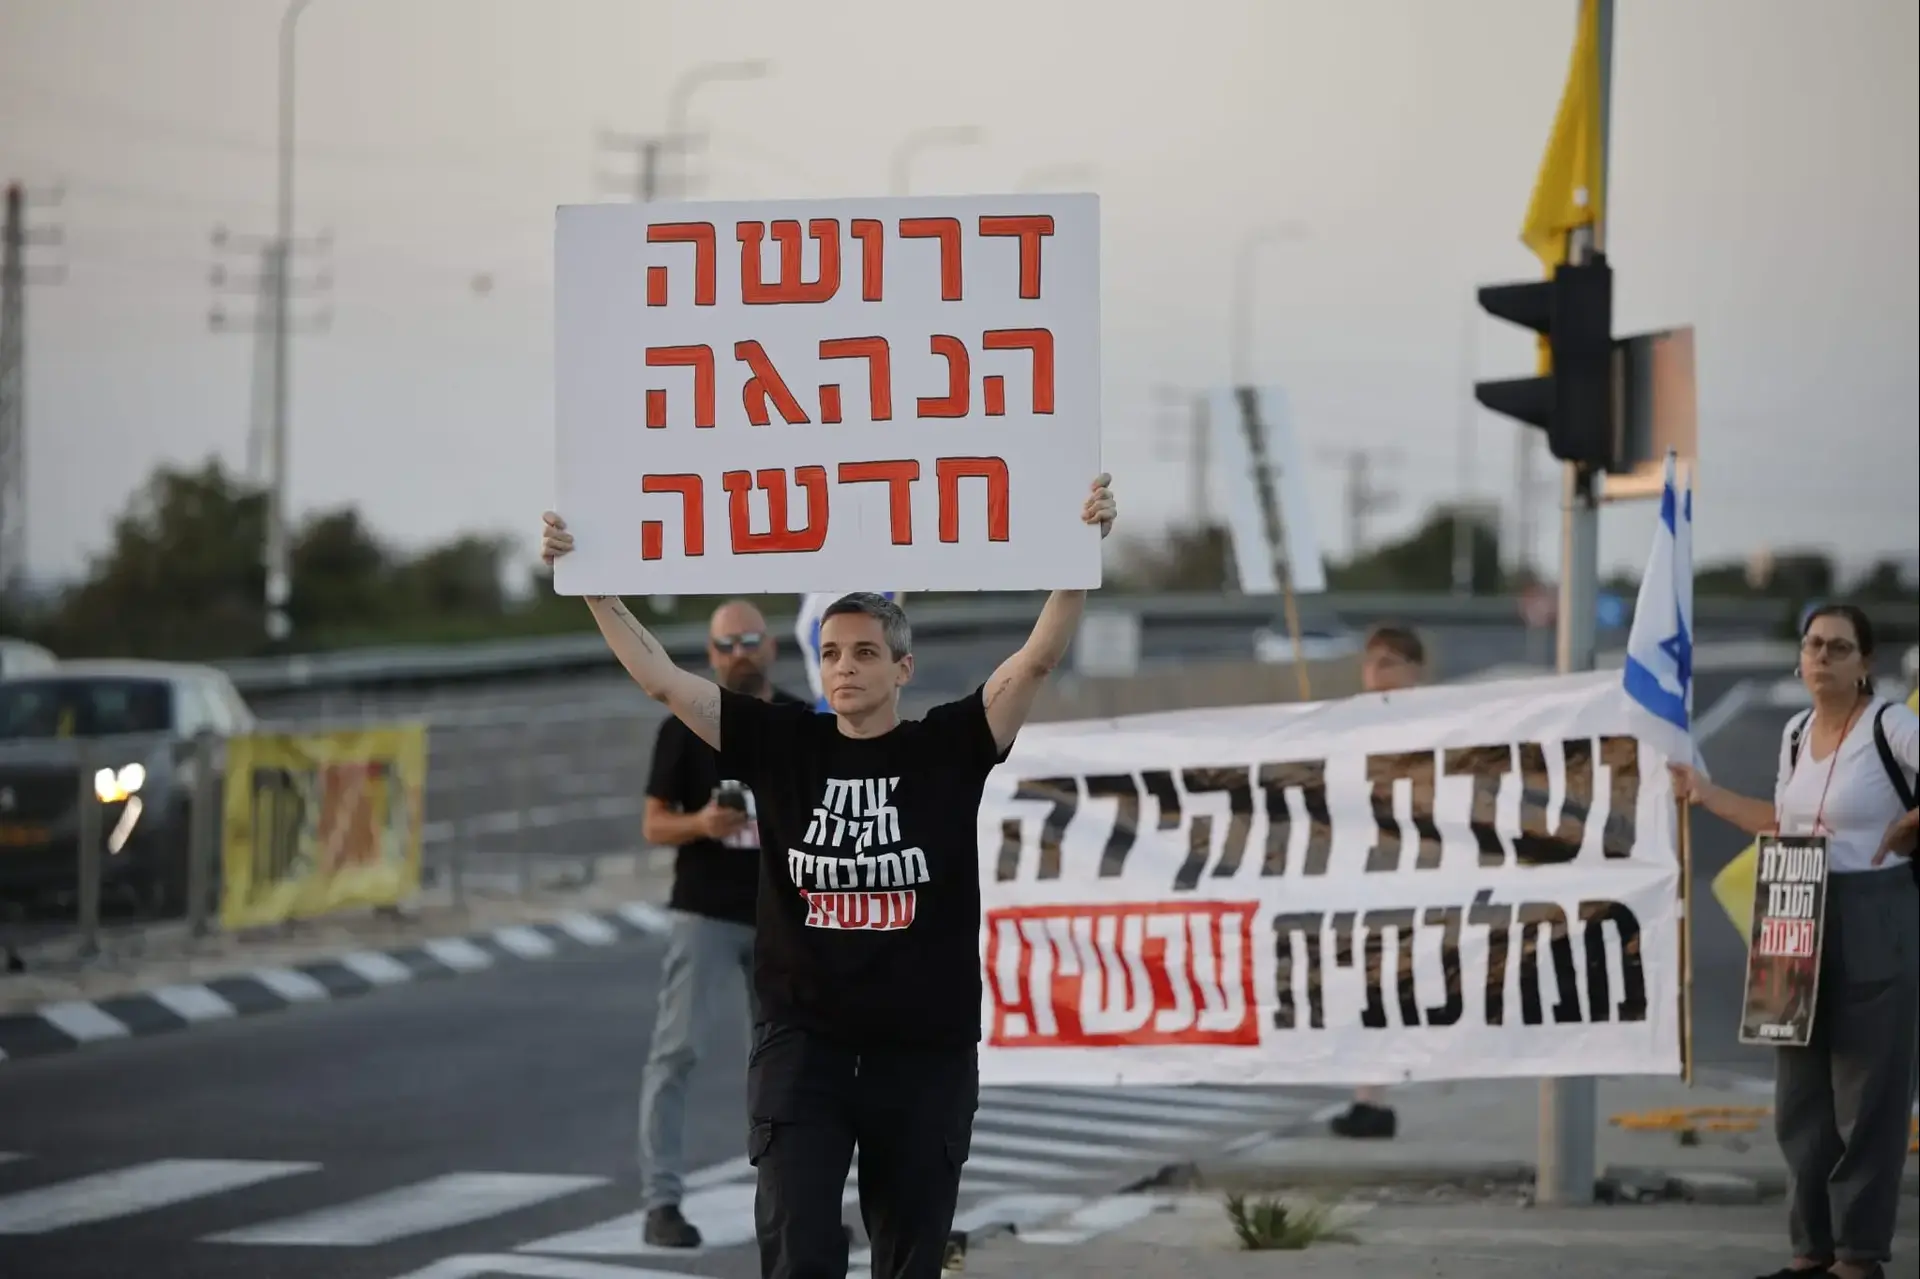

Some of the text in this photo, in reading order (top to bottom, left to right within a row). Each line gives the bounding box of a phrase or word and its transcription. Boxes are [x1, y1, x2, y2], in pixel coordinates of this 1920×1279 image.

[646, 215, 1055, 307] דרושה
[645, 327, 1055, 429] הנהגה
[641, 456, 1010, 561] חדשה
[994, 734, 1640, 892] ועדת חקירה
[1760, 842, 1824, 882] ממשלת
[788, 847, 930, 889] ממלכתית
[995, 888, 1649, 1039] ממלכתית עכשיו!
